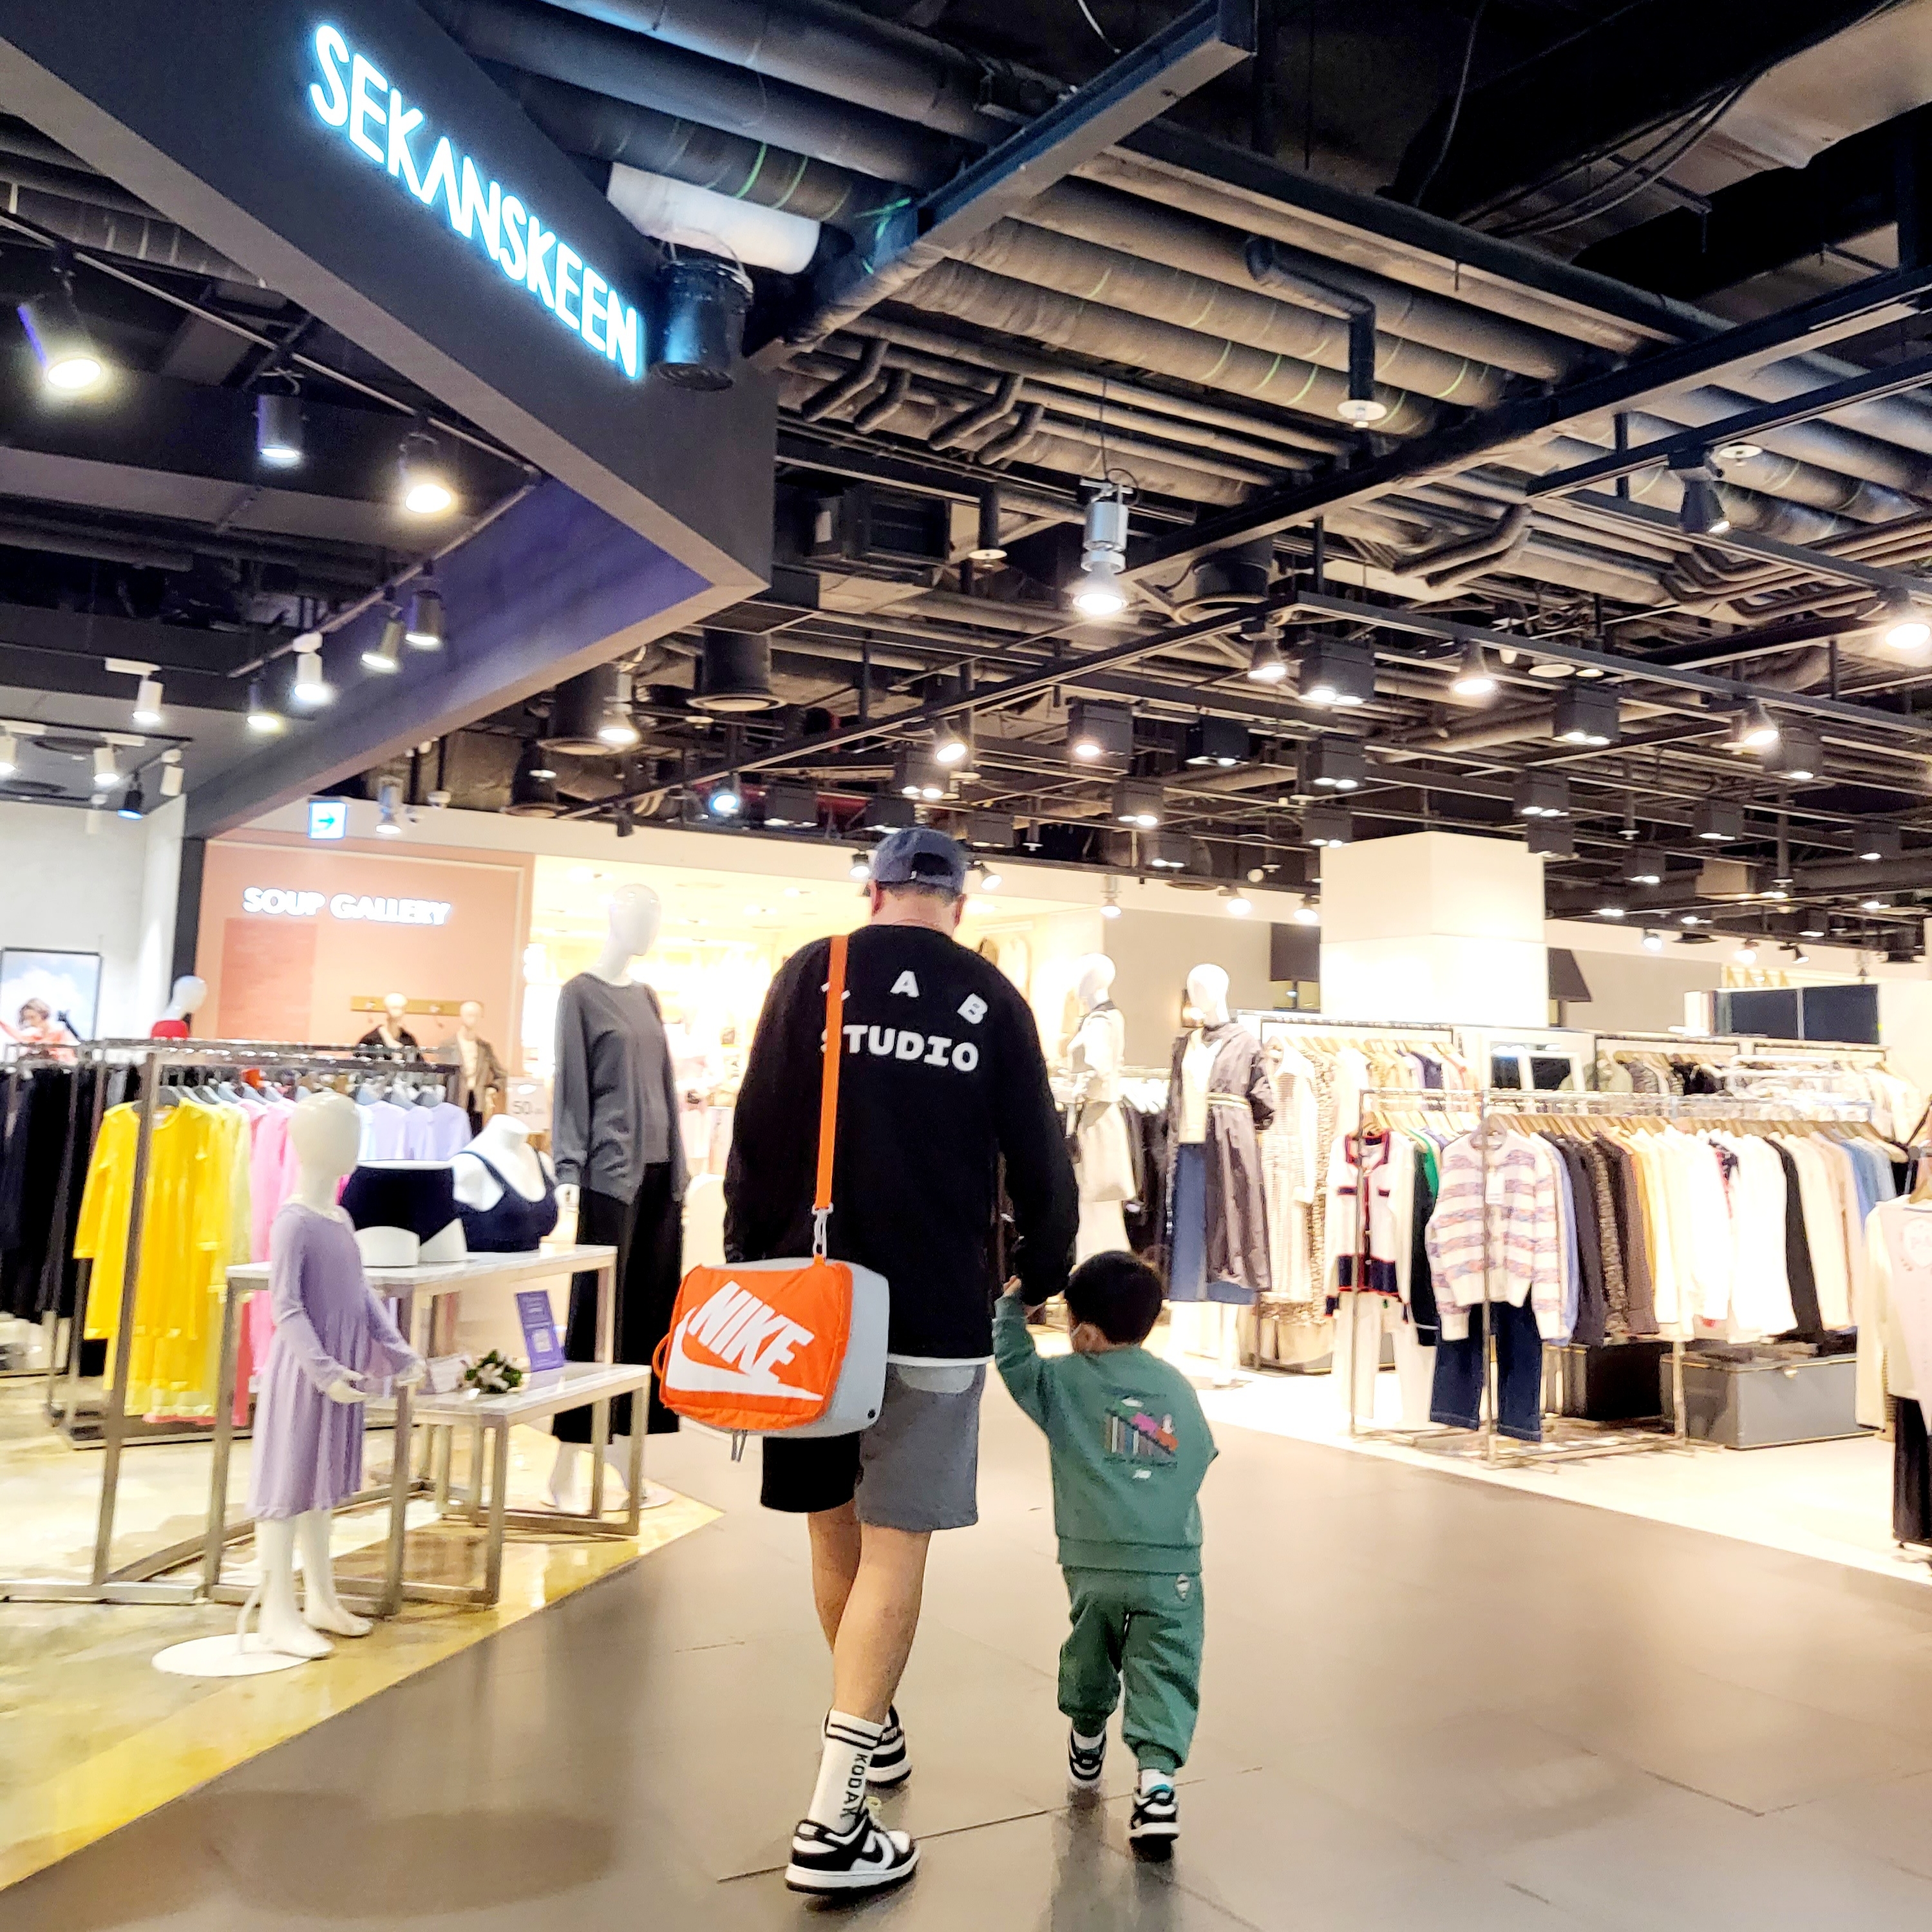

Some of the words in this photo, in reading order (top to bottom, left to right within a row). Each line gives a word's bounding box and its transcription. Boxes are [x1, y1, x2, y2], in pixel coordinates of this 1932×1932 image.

[242, 886, 327, 916] SOUP
[329, 893, 451, 926] GALLERY
[687, 1280, 815, 1385] NIKE
